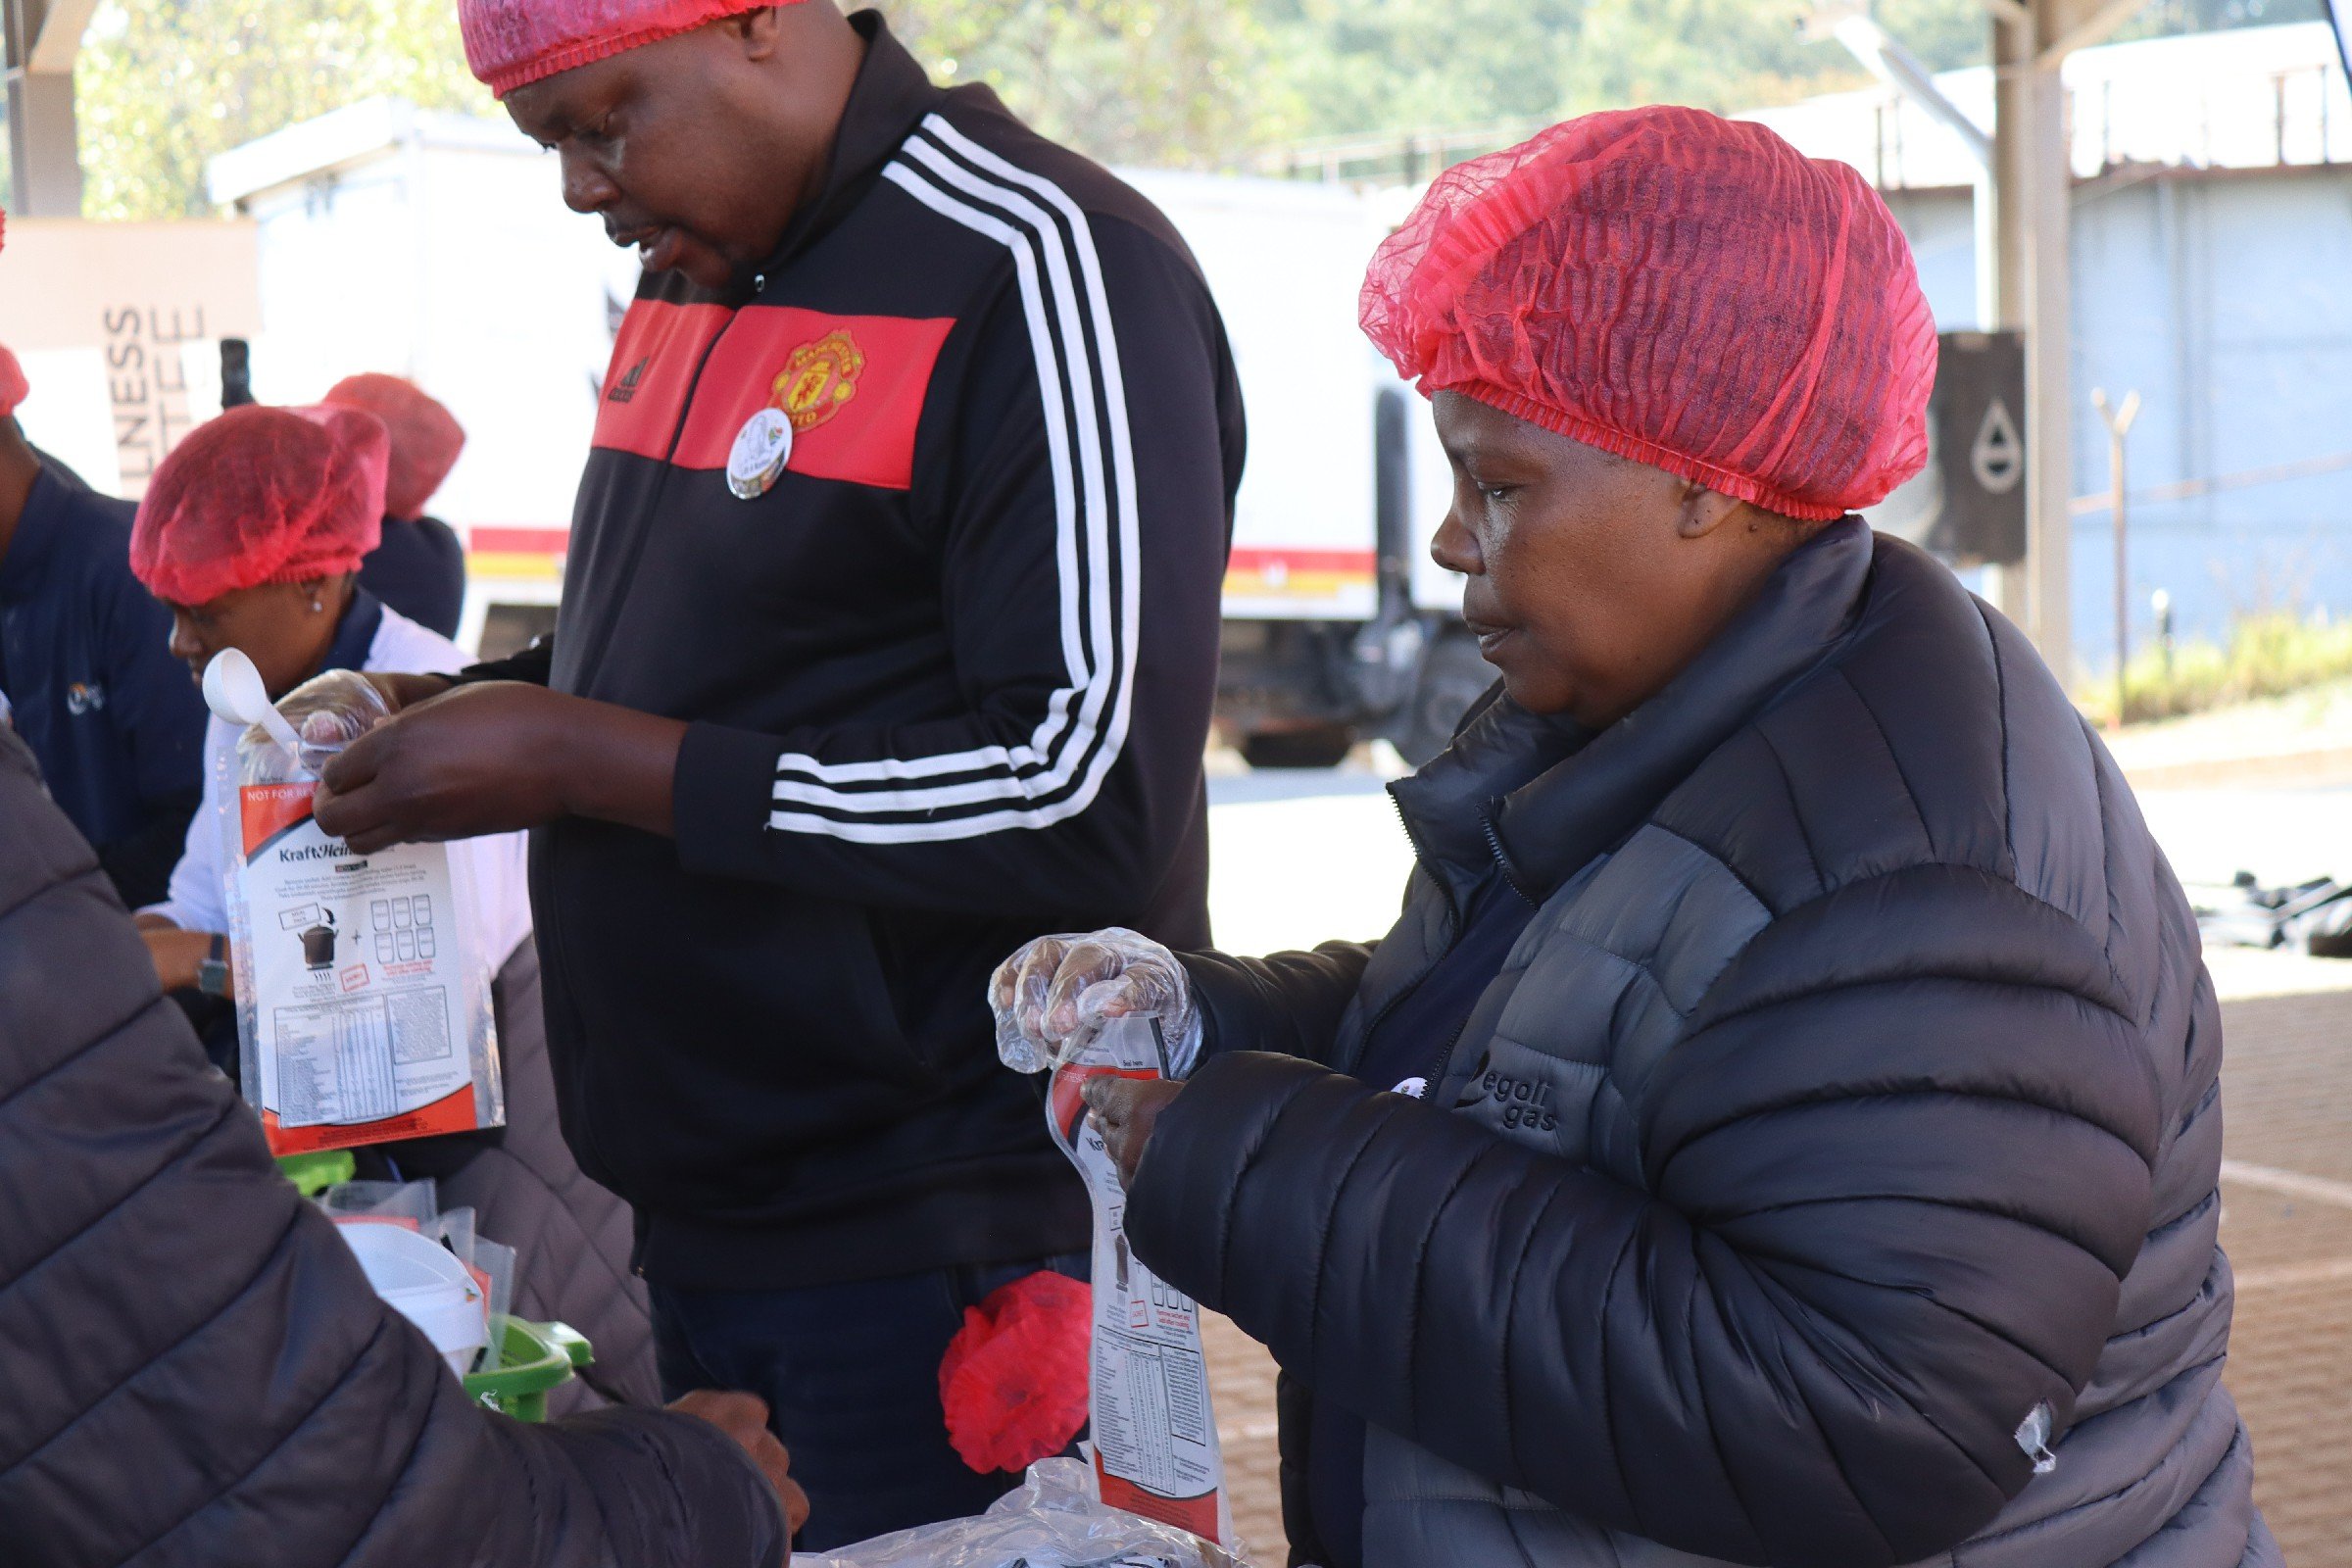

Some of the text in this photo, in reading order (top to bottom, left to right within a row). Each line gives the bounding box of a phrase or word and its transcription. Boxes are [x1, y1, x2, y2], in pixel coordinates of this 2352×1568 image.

[105, 304, 154, 479] LNESS
[247, 790, 270, 802] NOT
[272, 788, 294, 800] FOR
[1503, 1106, 1555, 1131] gas
